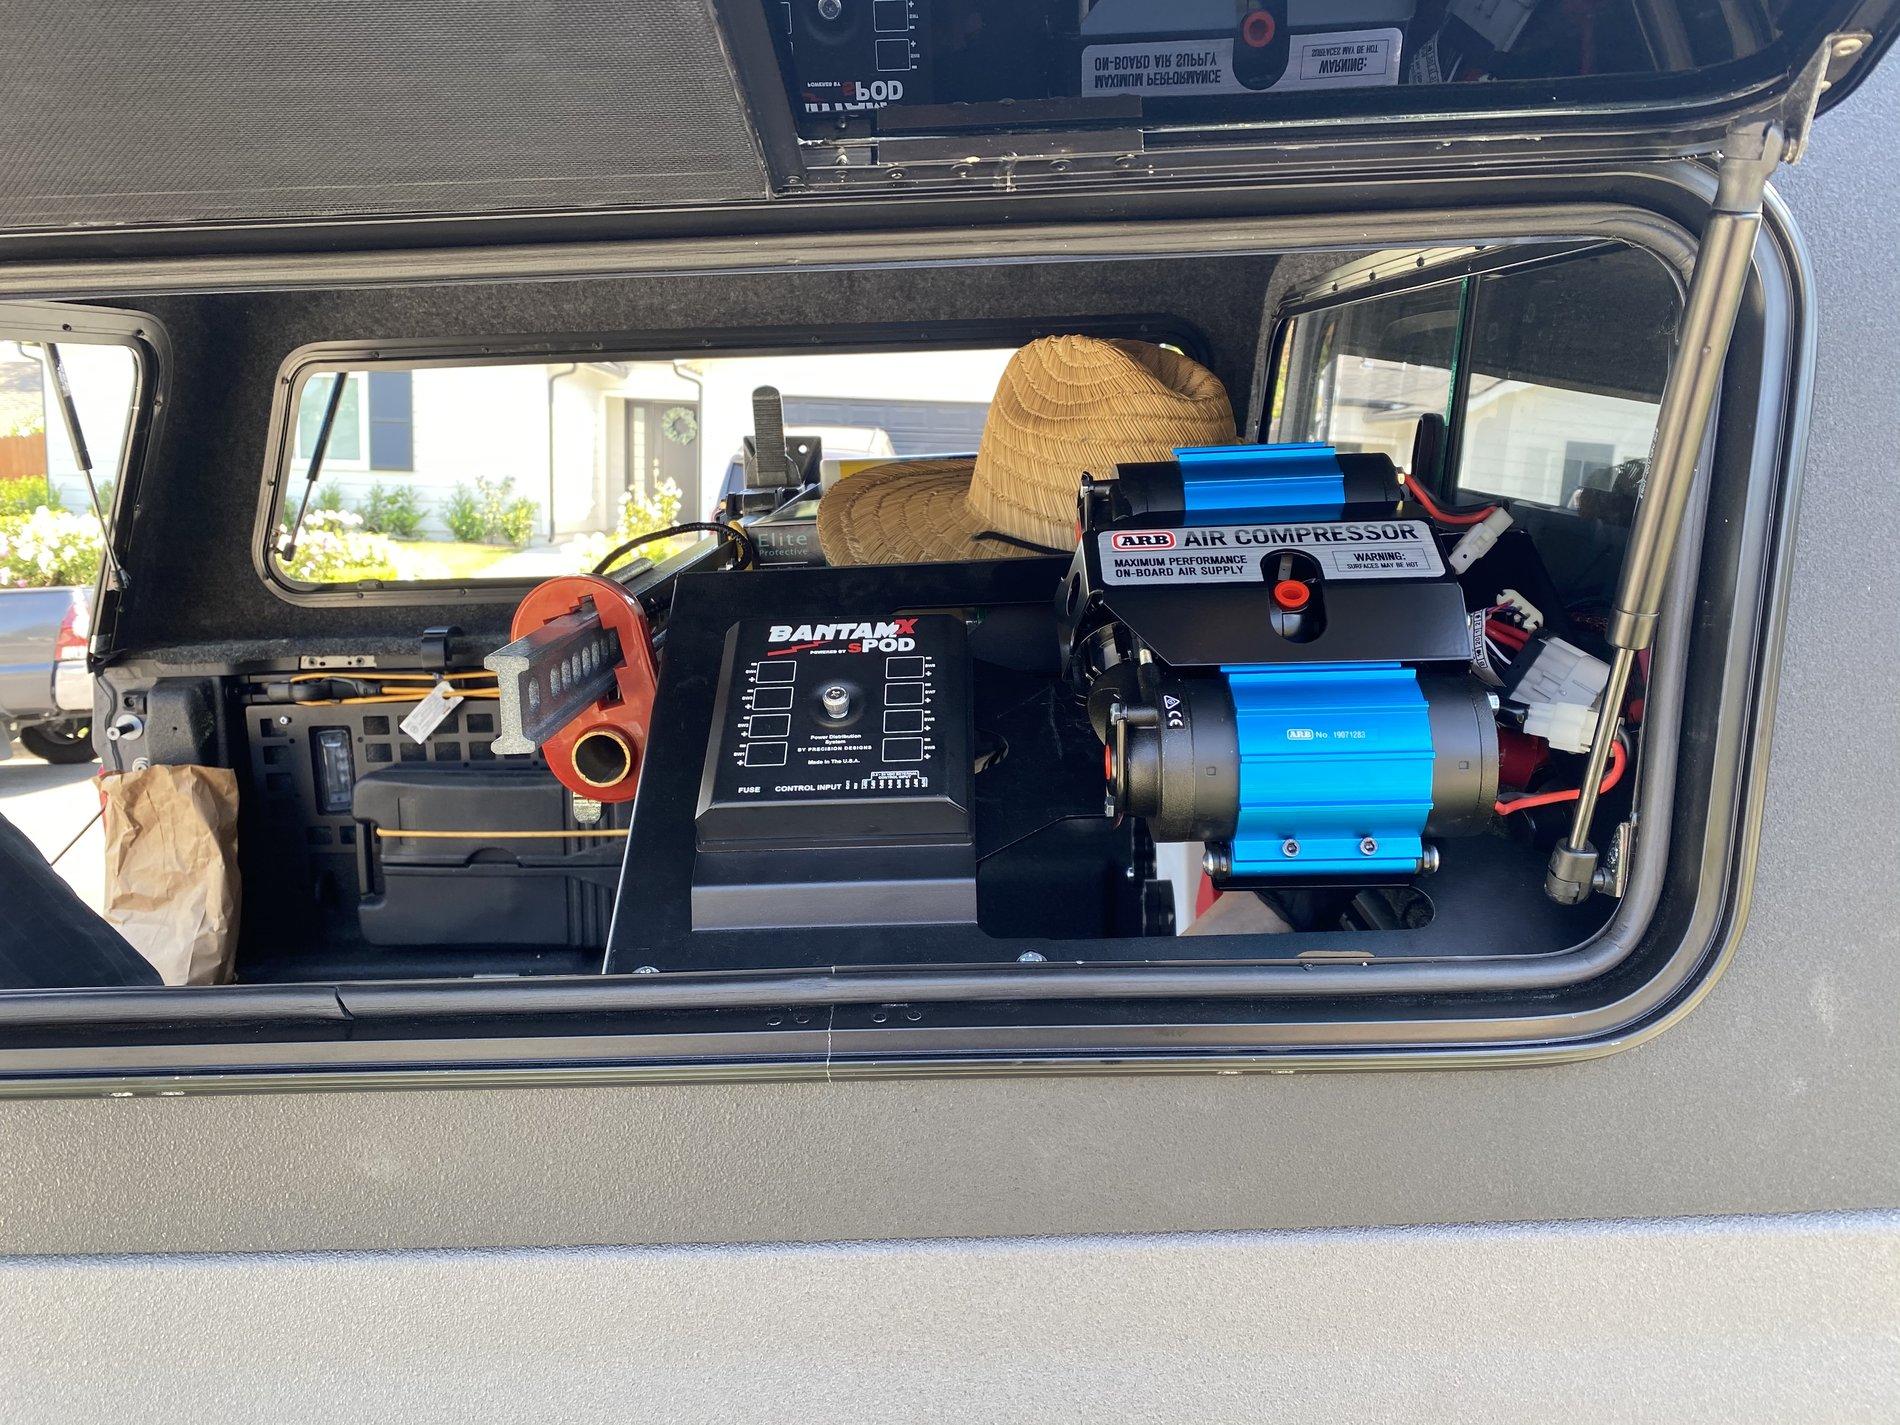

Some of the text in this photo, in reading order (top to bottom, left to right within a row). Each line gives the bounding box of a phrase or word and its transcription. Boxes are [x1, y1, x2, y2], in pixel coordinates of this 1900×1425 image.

[758, 532, 808, 548] Elite
[1121, 523, 1419, 547] ARB AIR COMPRESSOR
[758, 548, 808, 557] Protective
[1353, 552, 1407, 562] WARNING:
[1114, 555, 1248, 567] MAXIMUM PERFORMANCE
[1115, 565, 1244, 578] ON-BOARD AIR SUPPLY
[1289, 730, 1312, 738] ARB
